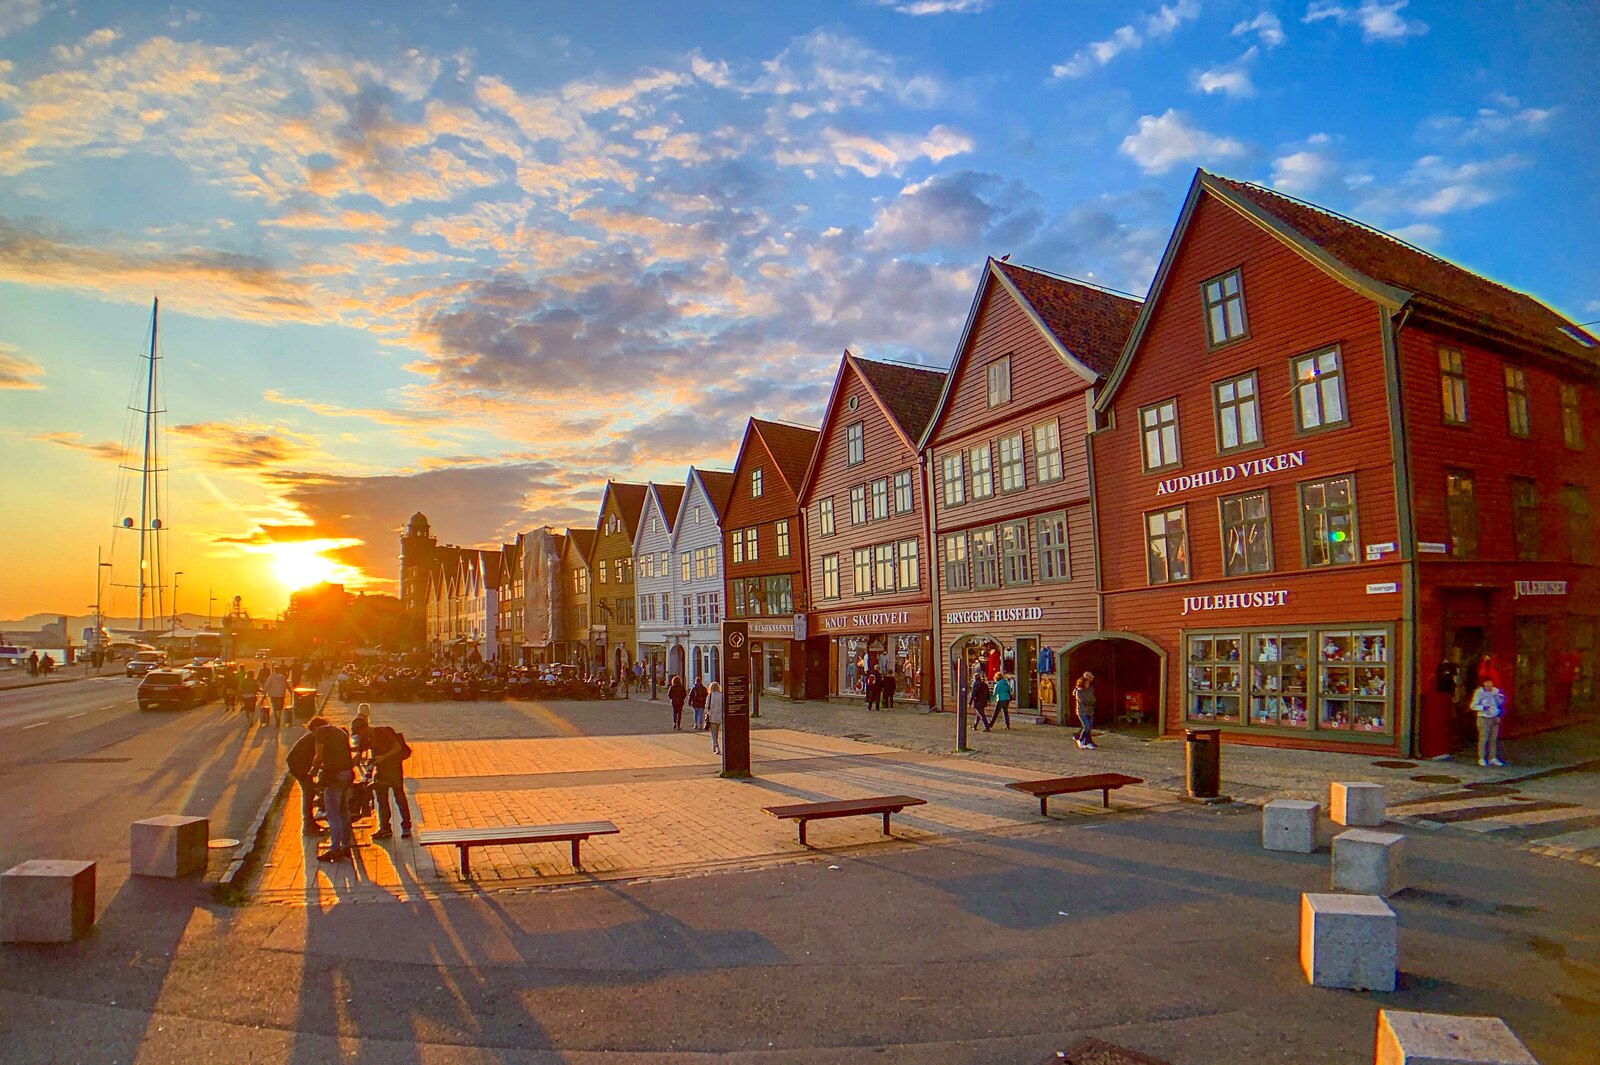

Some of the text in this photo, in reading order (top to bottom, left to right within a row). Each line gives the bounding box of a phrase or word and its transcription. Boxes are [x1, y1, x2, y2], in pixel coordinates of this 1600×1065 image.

[1156, 450, 1304, 495] AUDHILD VIKEN
[1181, 590, 1287, 615] JULEHUSET
[825, 612, 908, 628] KNUT SKURTVEIT
[946, 607, 1042, 624] BRYGGEN HUSFLID
